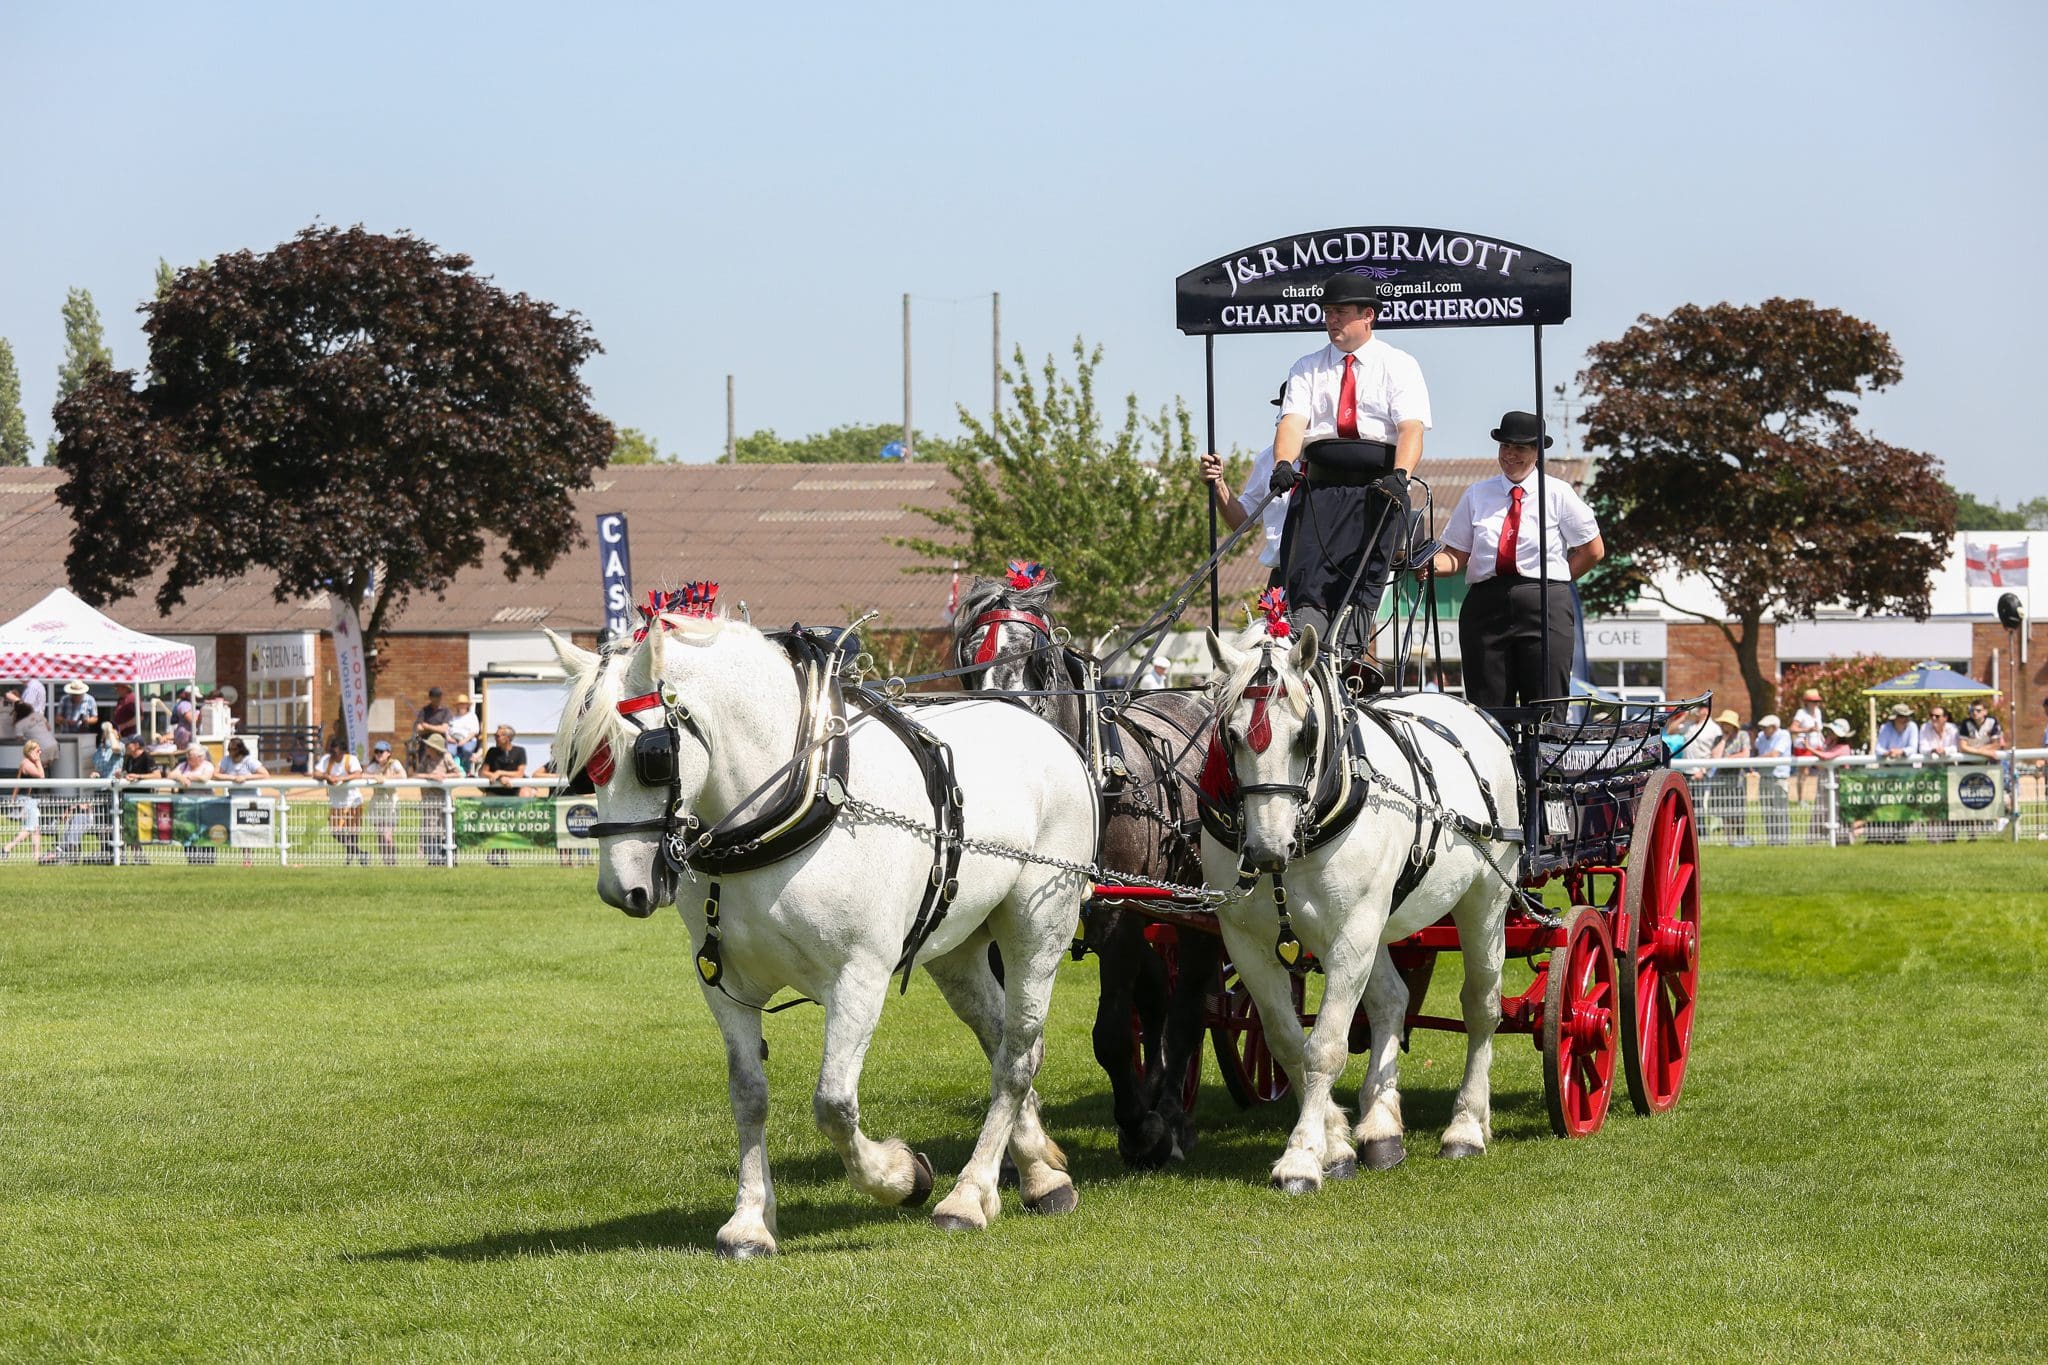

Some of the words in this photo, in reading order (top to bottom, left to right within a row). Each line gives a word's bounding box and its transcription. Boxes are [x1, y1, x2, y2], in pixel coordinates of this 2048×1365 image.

[1222, 246, 1289, 298] J&R
[1221, 303, 1327, 327] CHARFO
[1377, 297, 1523, 322] ERCHERONS
[602, 516, 626, 639] CASH
[1846, 782, 1864, 793] SO
[1866, 780, 1903, 792] MUCH
[1906, 780, 1942, 791] MORE
[1847, 795, 1862, 805] IN
[1864, 794, 1905, 804] EVERY
[1906, 793, 1942, 804] DROP
[463, 810, 478, 820] SO
[481, 810, 515, 820] MUCH
[519, 810, 551, 820] MORE
[463, 823, 476, 832] IN
[479, 823, 516, 832] EVERY
[518, 823, 551, 832] DROP
